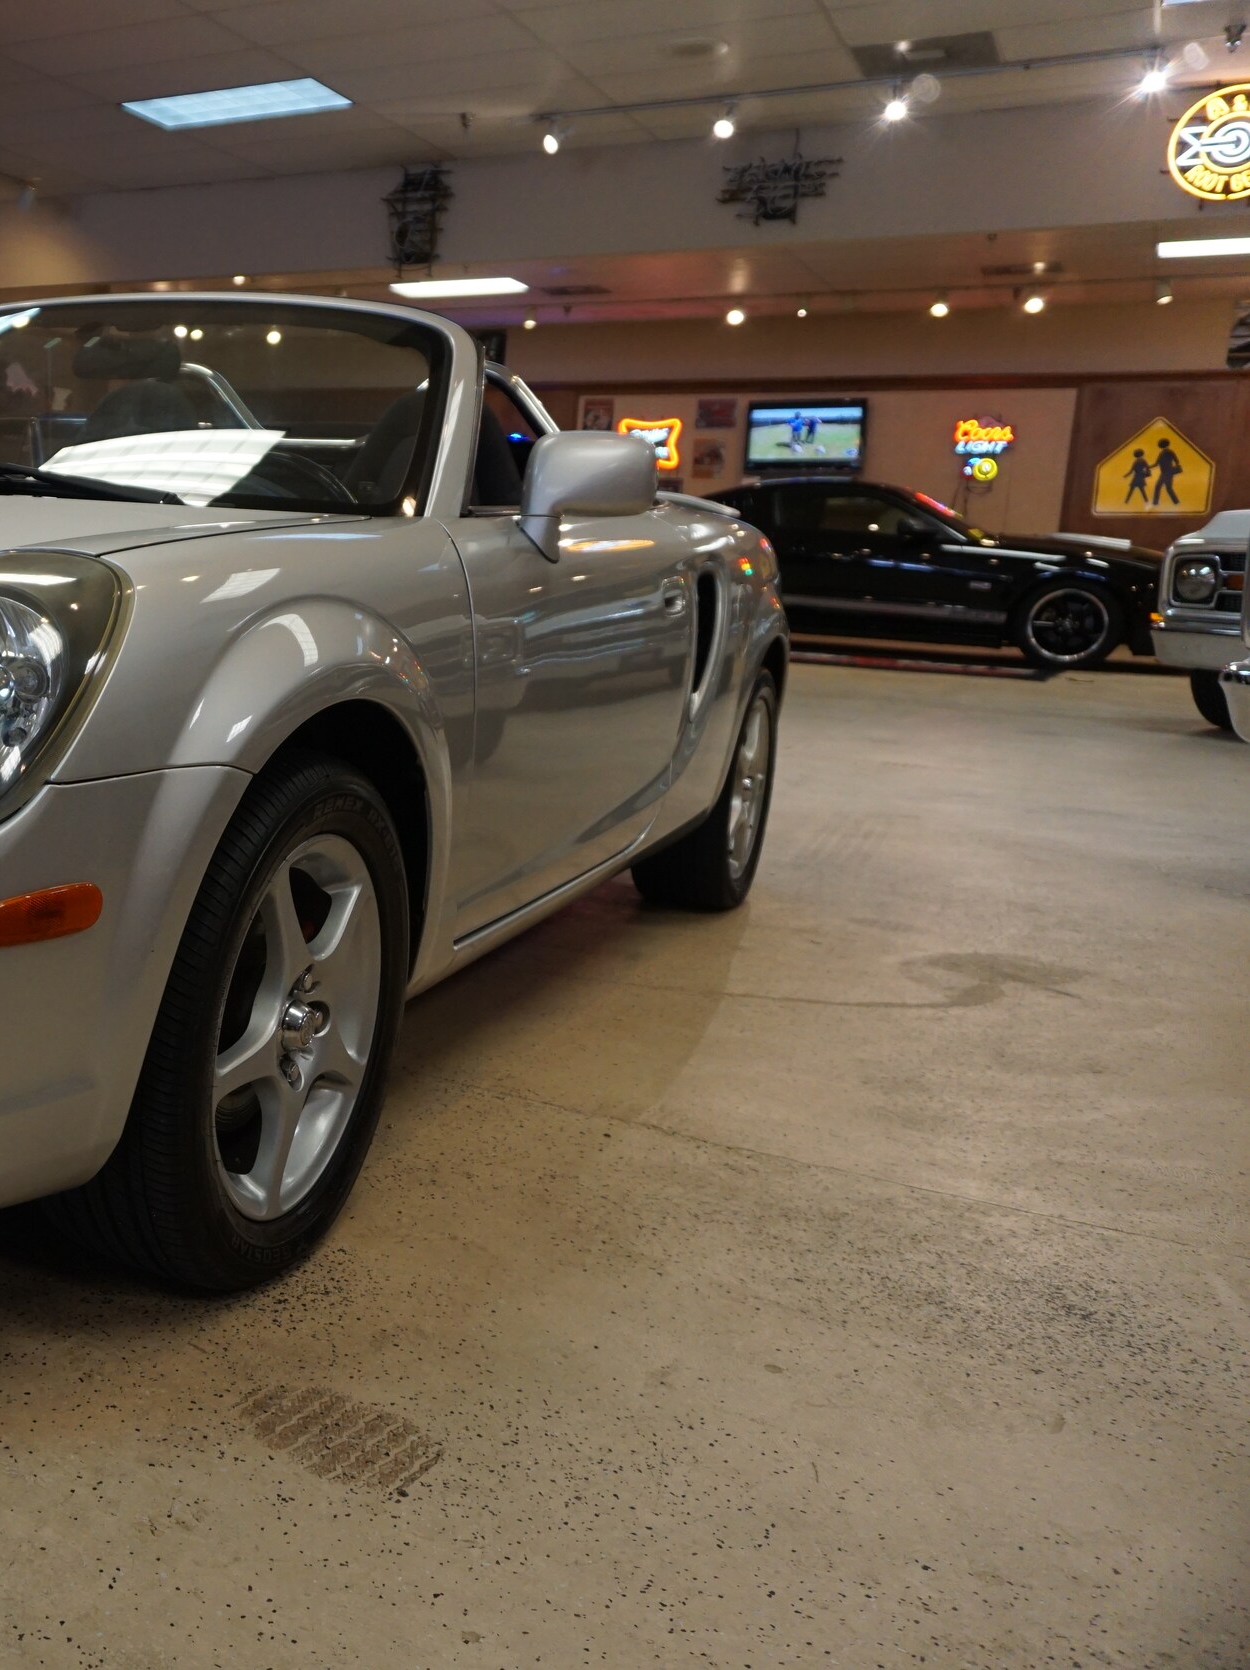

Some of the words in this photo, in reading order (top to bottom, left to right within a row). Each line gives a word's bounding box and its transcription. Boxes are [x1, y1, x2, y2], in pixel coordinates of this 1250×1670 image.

[1183, 165, 1228, 193] ROOT
[953, 419, 1014, 442] Coors
[955, 441, 1008, 454] LIGHT
